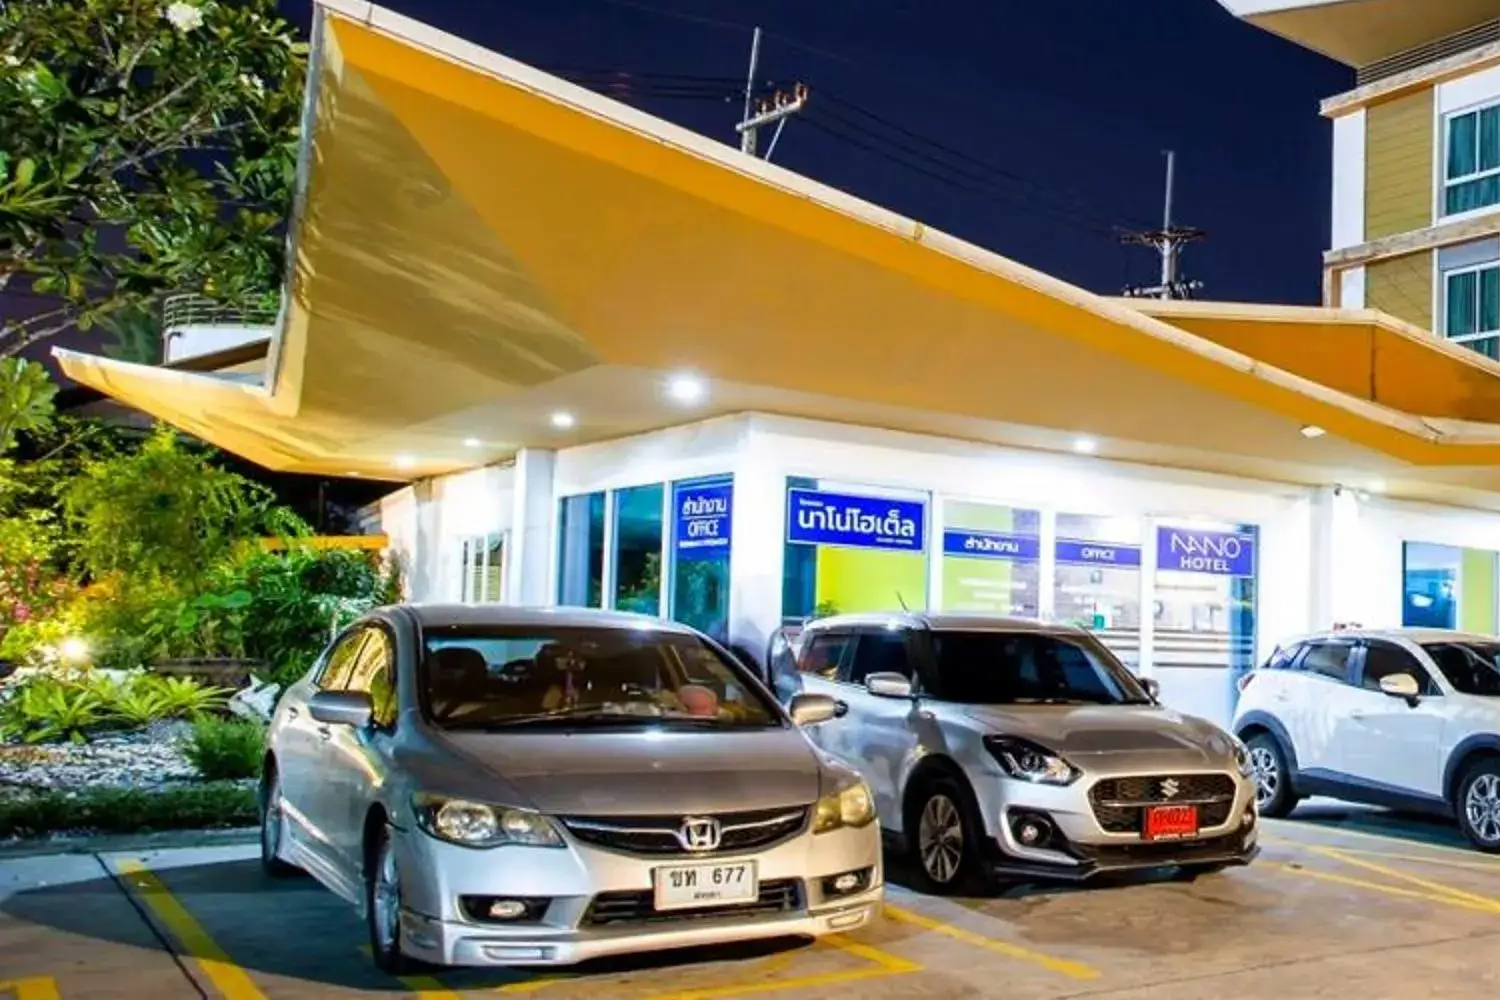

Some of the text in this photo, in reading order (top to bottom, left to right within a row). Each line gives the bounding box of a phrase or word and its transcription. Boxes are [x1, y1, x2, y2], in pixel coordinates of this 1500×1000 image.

[682, 496, 727, 515] สำนักงาน
[687, 519, 719, 537] OFFICE
[798, 505, 915, 537] นาโนโฮเต็ล
[1170, 532, 1241, 559] NANO
[1180, 557, 1231, 573] HOTEL
[712, 866, 745, 884] 677
